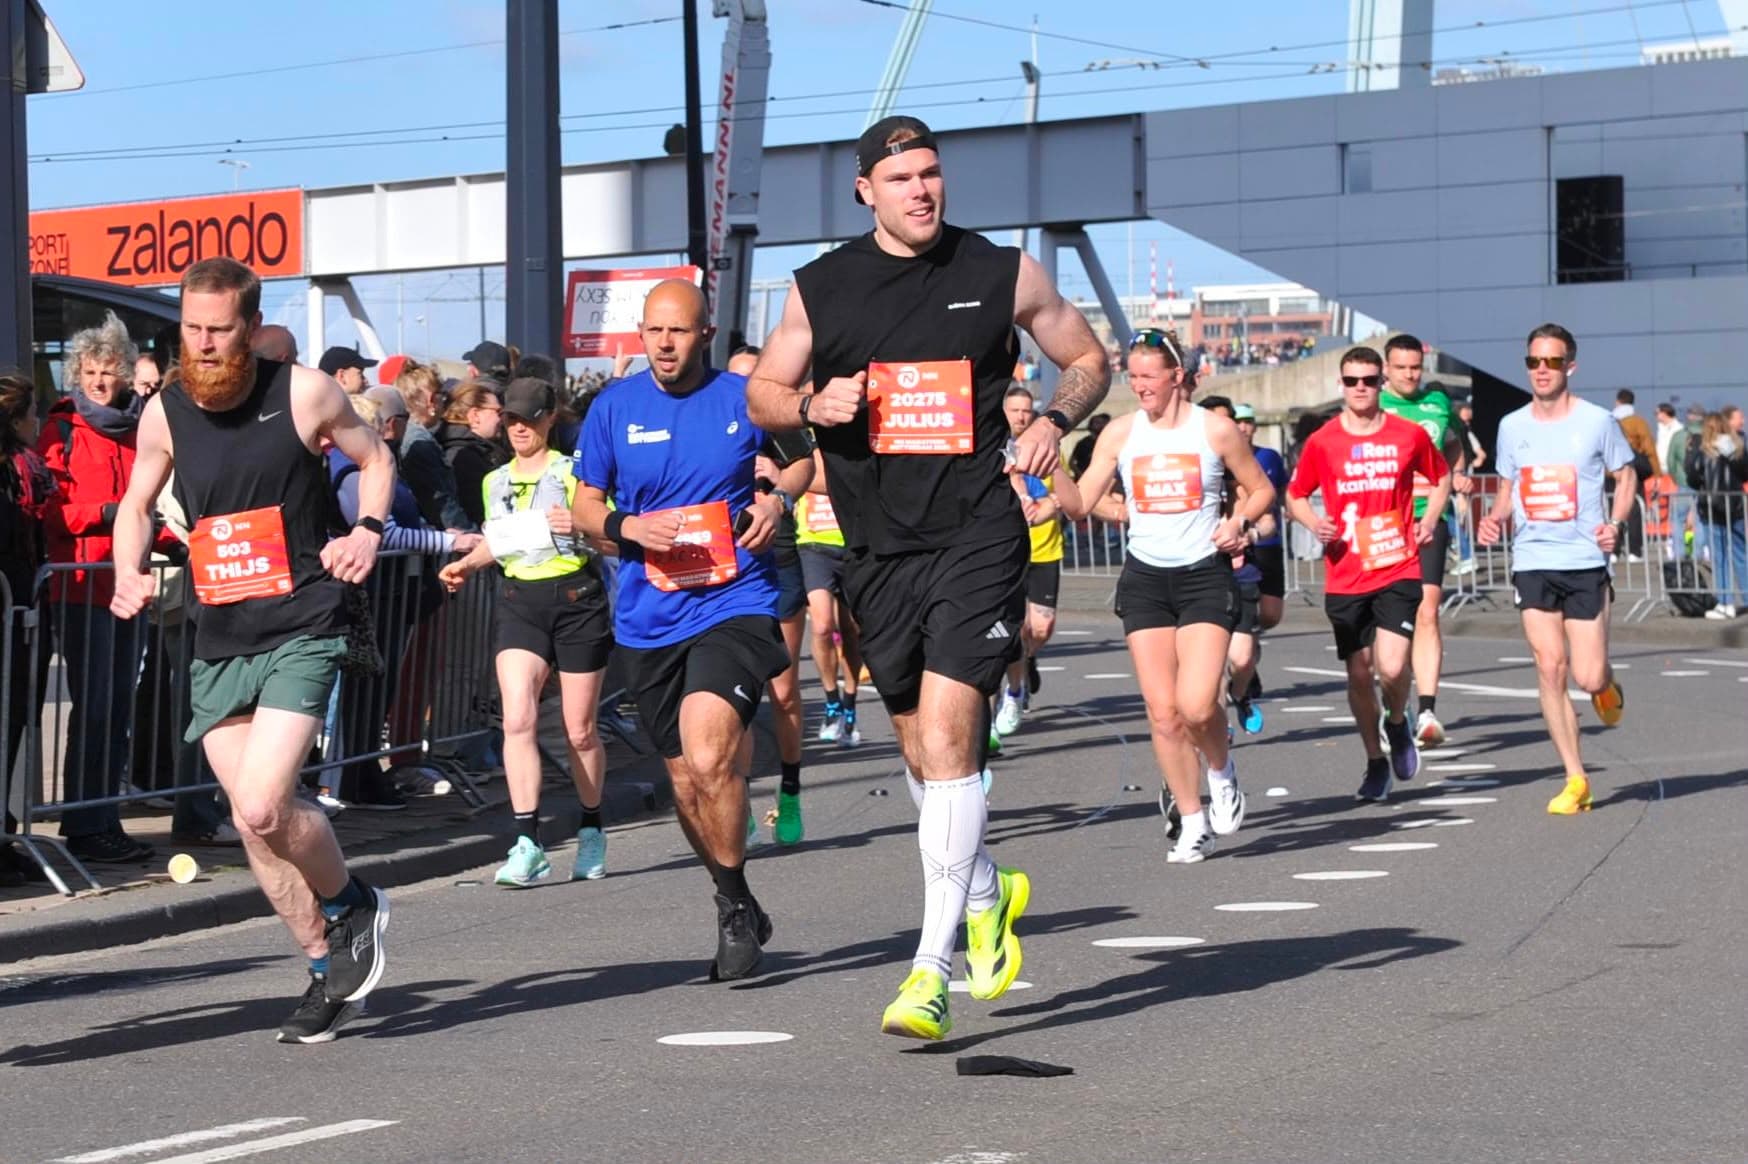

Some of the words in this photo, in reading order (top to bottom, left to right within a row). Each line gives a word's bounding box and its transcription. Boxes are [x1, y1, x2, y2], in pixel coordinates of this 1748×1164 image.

[107, 202, 288, 276] zalando
[890, 391, 947, 407] 20275
[884, 412, 955, 428] JULIUS
[1351, 442, 1398, 459] #Ren
[1344, 460, 1399, 478] tegen
[1144, 481, 1187, 497] MAX
[1336, 477, 1396, 495] kanker
[217, 541, 252, 558] 503
[205, 556, 271, 581] THIJS
